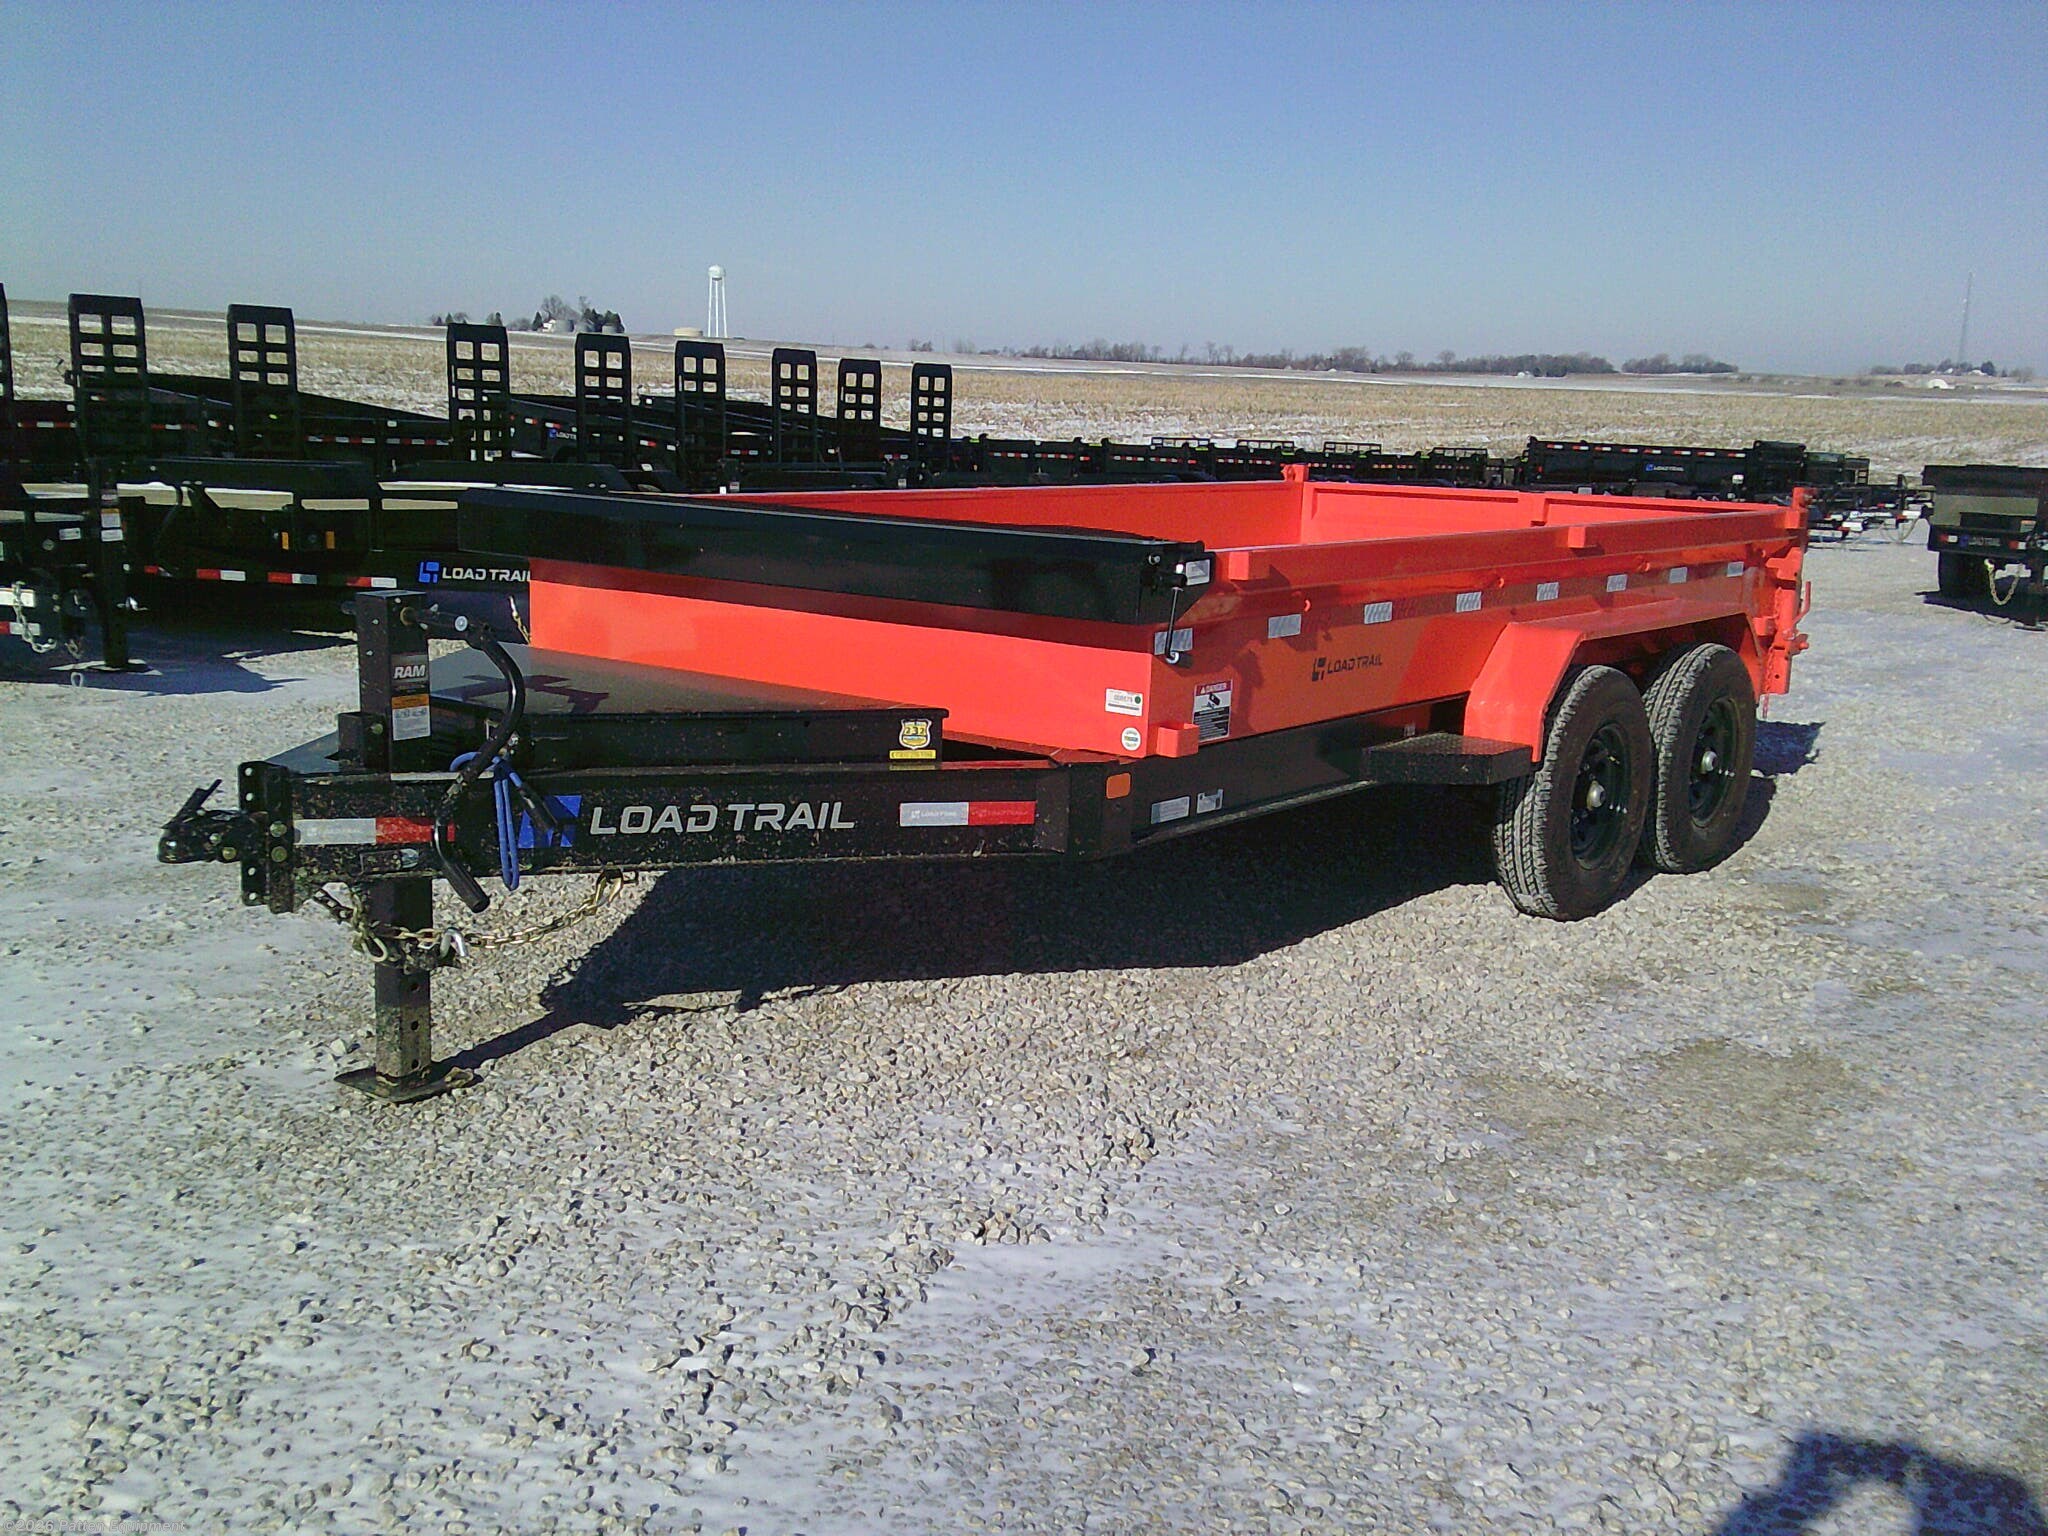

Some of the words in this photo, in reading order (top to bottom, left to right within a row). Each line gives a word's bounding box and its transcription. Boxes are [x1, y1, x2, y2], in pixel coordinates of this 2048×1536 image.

[442, 567, 487, 580] LOAD
[394, 664, 426, 679] RAM
[1327, 658, 1355, 674] LOAD
[1356, 653, 1383, 669] TRAIL
[589, 804, 719, 834] LOAD
[727, 801, 856, 832] TRAIL
